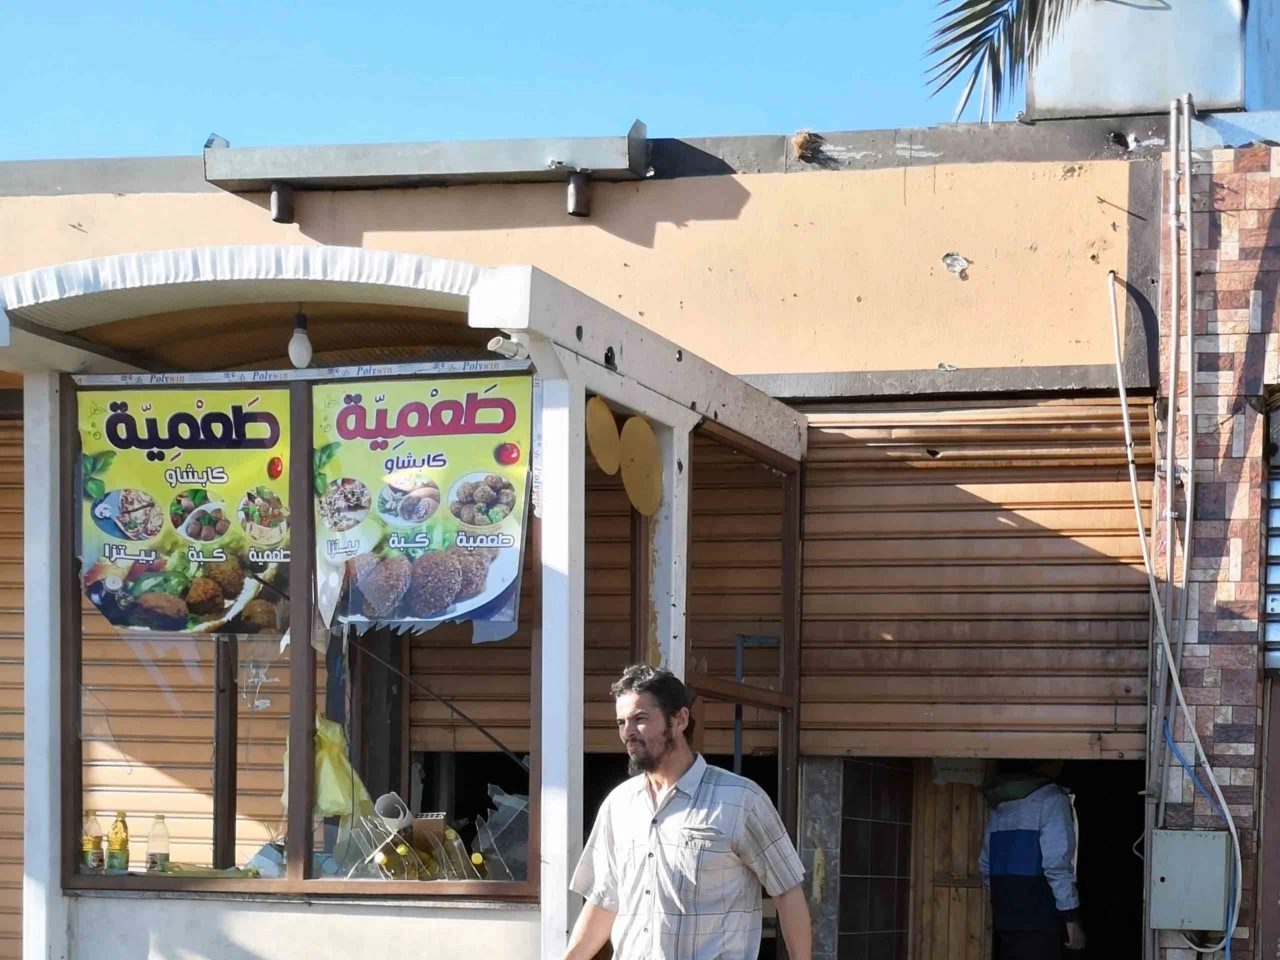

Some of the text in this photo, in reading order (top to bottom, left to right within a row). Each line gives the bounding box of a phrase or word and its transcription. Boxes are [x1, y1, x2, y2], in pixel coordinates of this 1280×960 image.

[384, 452, 447, 474] كابشاو
[164, 464, 229, 488] كابشاو
[455, 531, 515, 552] طعمية
